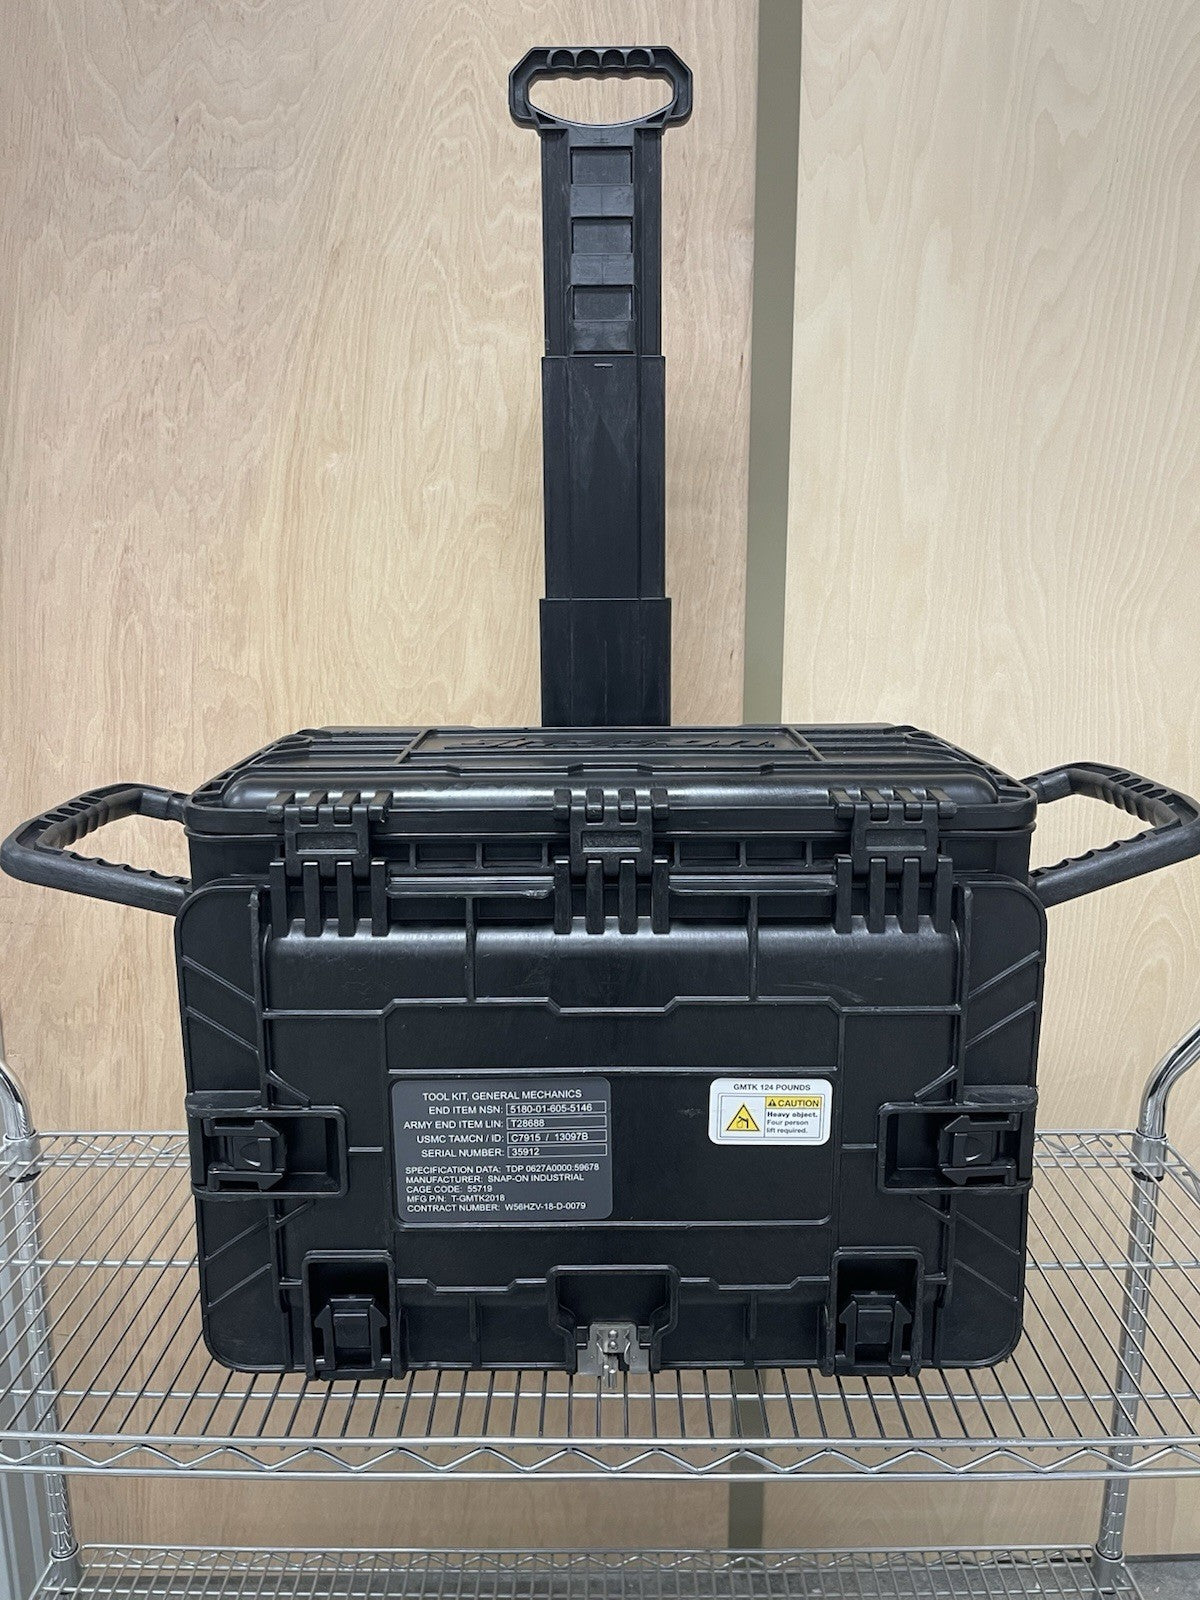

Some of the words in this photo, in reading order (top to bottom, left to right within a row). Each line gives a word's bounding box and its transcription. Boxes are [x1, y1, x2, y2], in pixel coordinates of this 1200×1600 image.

[423, 1092, 450, 1101] TOOL
[451, 1092, 471, 1102] KIT,
[471, 1090, 520, 1101] GENERAL
[522, 1089, 582, 1099] MECHANICS
[429, 1106, 451, 1114] END
[453, 1105, 478, 1114] ITEM
[479, 1104, 503, 1114] NSN:
[510, 1103, 593, 1113] 5180-01-605-5146
[777, 1099, 820, 1107] CAUTION
[404, 1121, 432, 1130] ARMY
[435, 1120, 456, 1129] END
[458, 1120, 483, 1128] ITEM
[485, 1119, 504, 1128] LIN:
[511, 1119, 545, 1128] T28688
[416, 1135, 446, 1143] USMC
[448, 1134, 484, 1143] TAMCN
[491, 1133, 505, 1142] ID:
[511, 1133, 541, 1142] C7915
[554, 1132, 588, 1141] 13097B
[421, 1149, 456, 1158] SERIAL
[458, 1148, 505, 1157] NUMBER:
[512, 1147, 540, 1156] 35912
[405, 1166, 474, 1174] SPECIFICATION
[475, 1165, 501, 1173] DATA:
[506, 1165, 525, 1173] TDP
[406, 1175, 483, 1184] MANUFACTURER:
[487, 1174, 529, 1183] SNAP-ON
[531, 1173, 585, 1182] INDUSTRIAL
[406, 1185, 432, 1193] CAGE
[434, 1185, 463, 1193] CODE:
[467, 1185, 493, 1193] 55719
[406, 1194, 427, 1203] MFG
[429, 1194, 447, 1202] P/N:
[451, 1193, 506, 1202] T-GMTK2018
[406, 1204, 458, 1212] CONTRACT
[459, 1203, 501, 1212] NUMBER:
